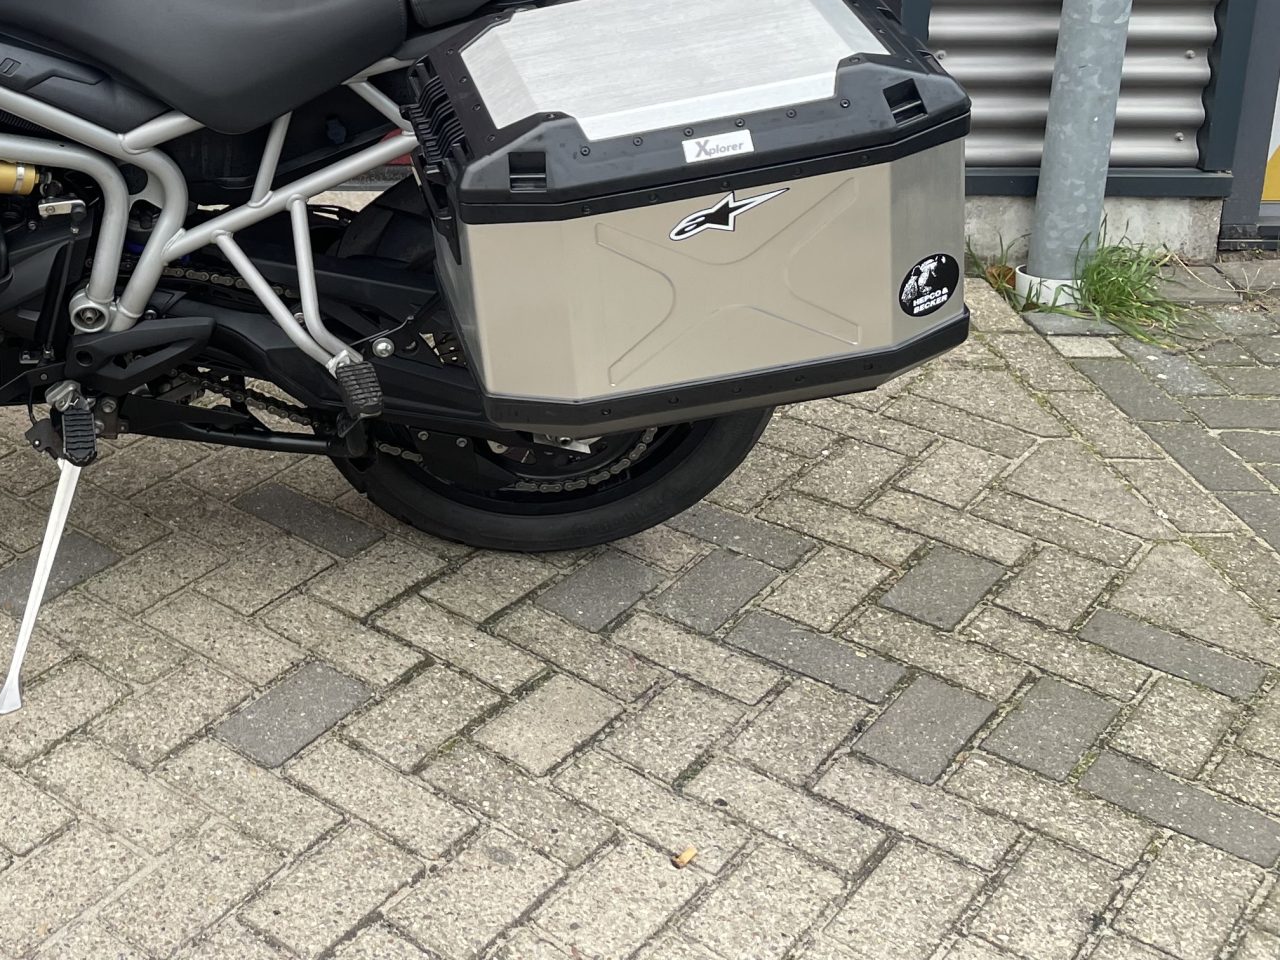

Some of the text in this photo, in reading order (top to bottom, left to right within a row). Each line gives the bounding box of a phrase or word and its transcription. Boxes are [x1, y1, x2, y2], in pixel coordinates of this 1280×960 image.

[695, 139, 745, 159] Xplorer
[913, 289, 941, 307] HEPCO
[913, 294, 948, 314] BECKER
